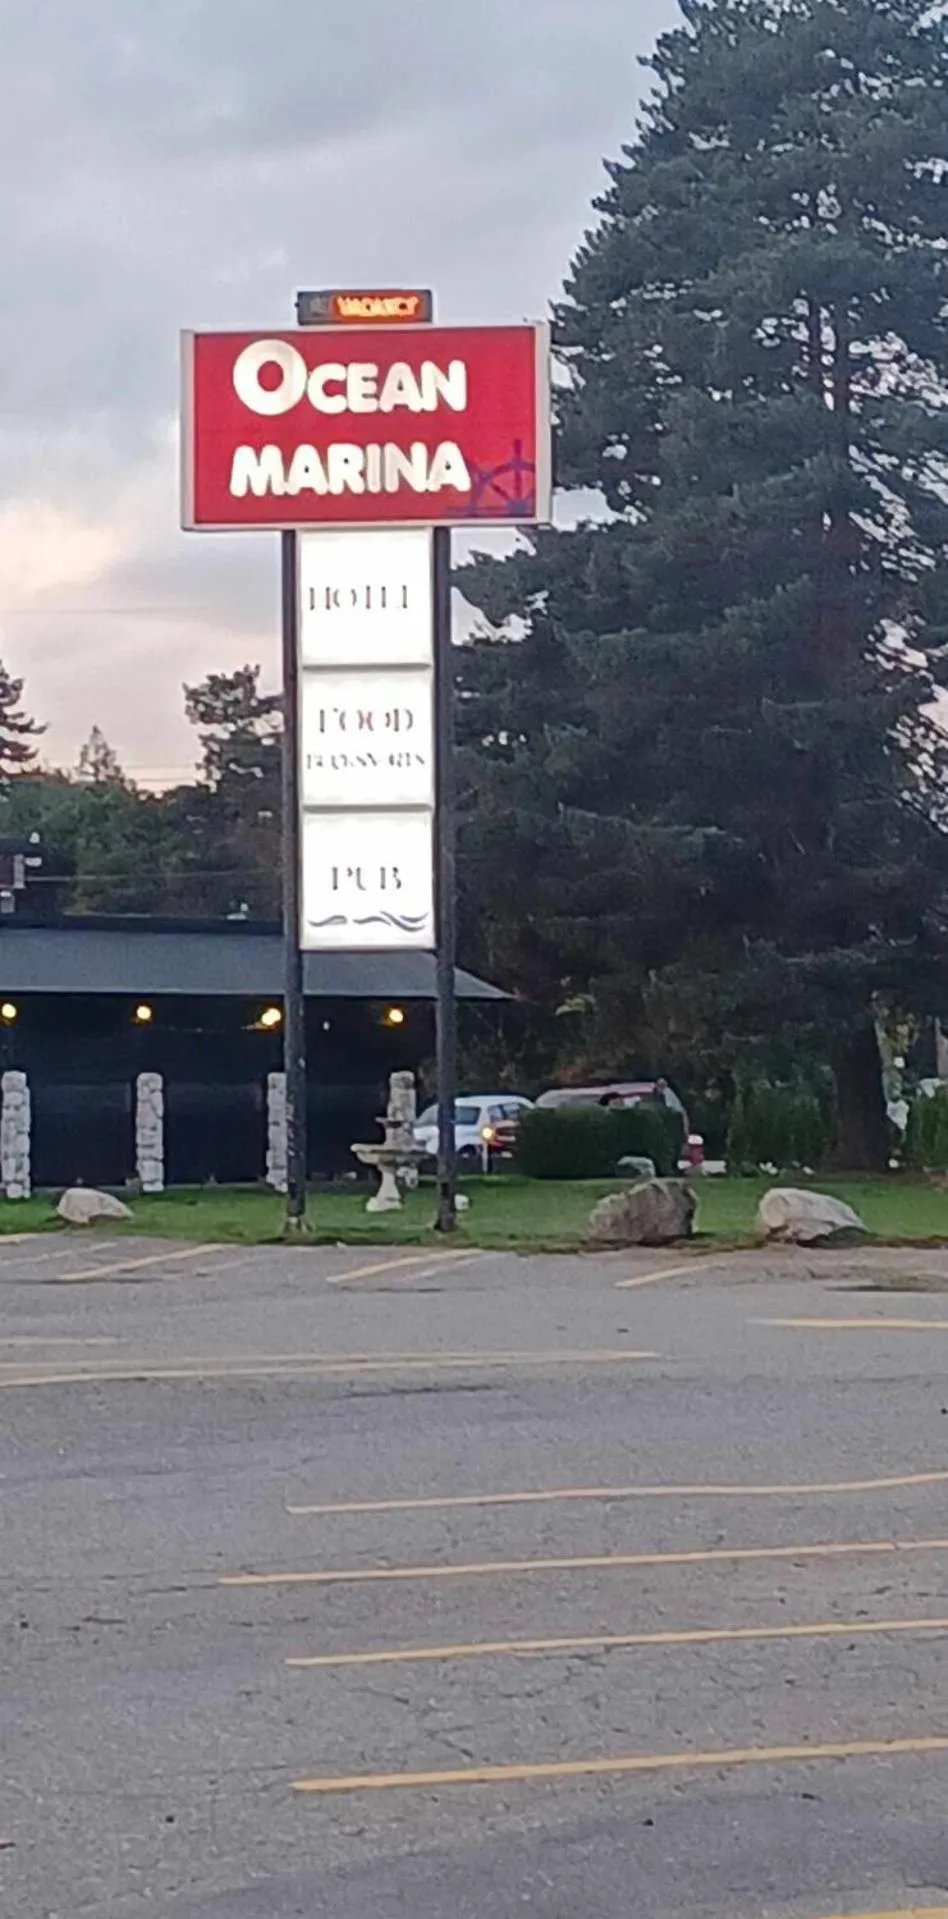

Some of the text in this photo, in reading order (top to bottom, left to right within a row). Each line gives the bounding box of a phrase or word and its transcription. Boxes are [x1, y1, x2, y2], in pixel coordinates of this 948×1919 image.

[232, 338, 467, 416] OCEAN
[229, 441, 472, 497] MARINA
[319, 707, 414, 733] FOOD
[331, 865, 402, 891] PUB
